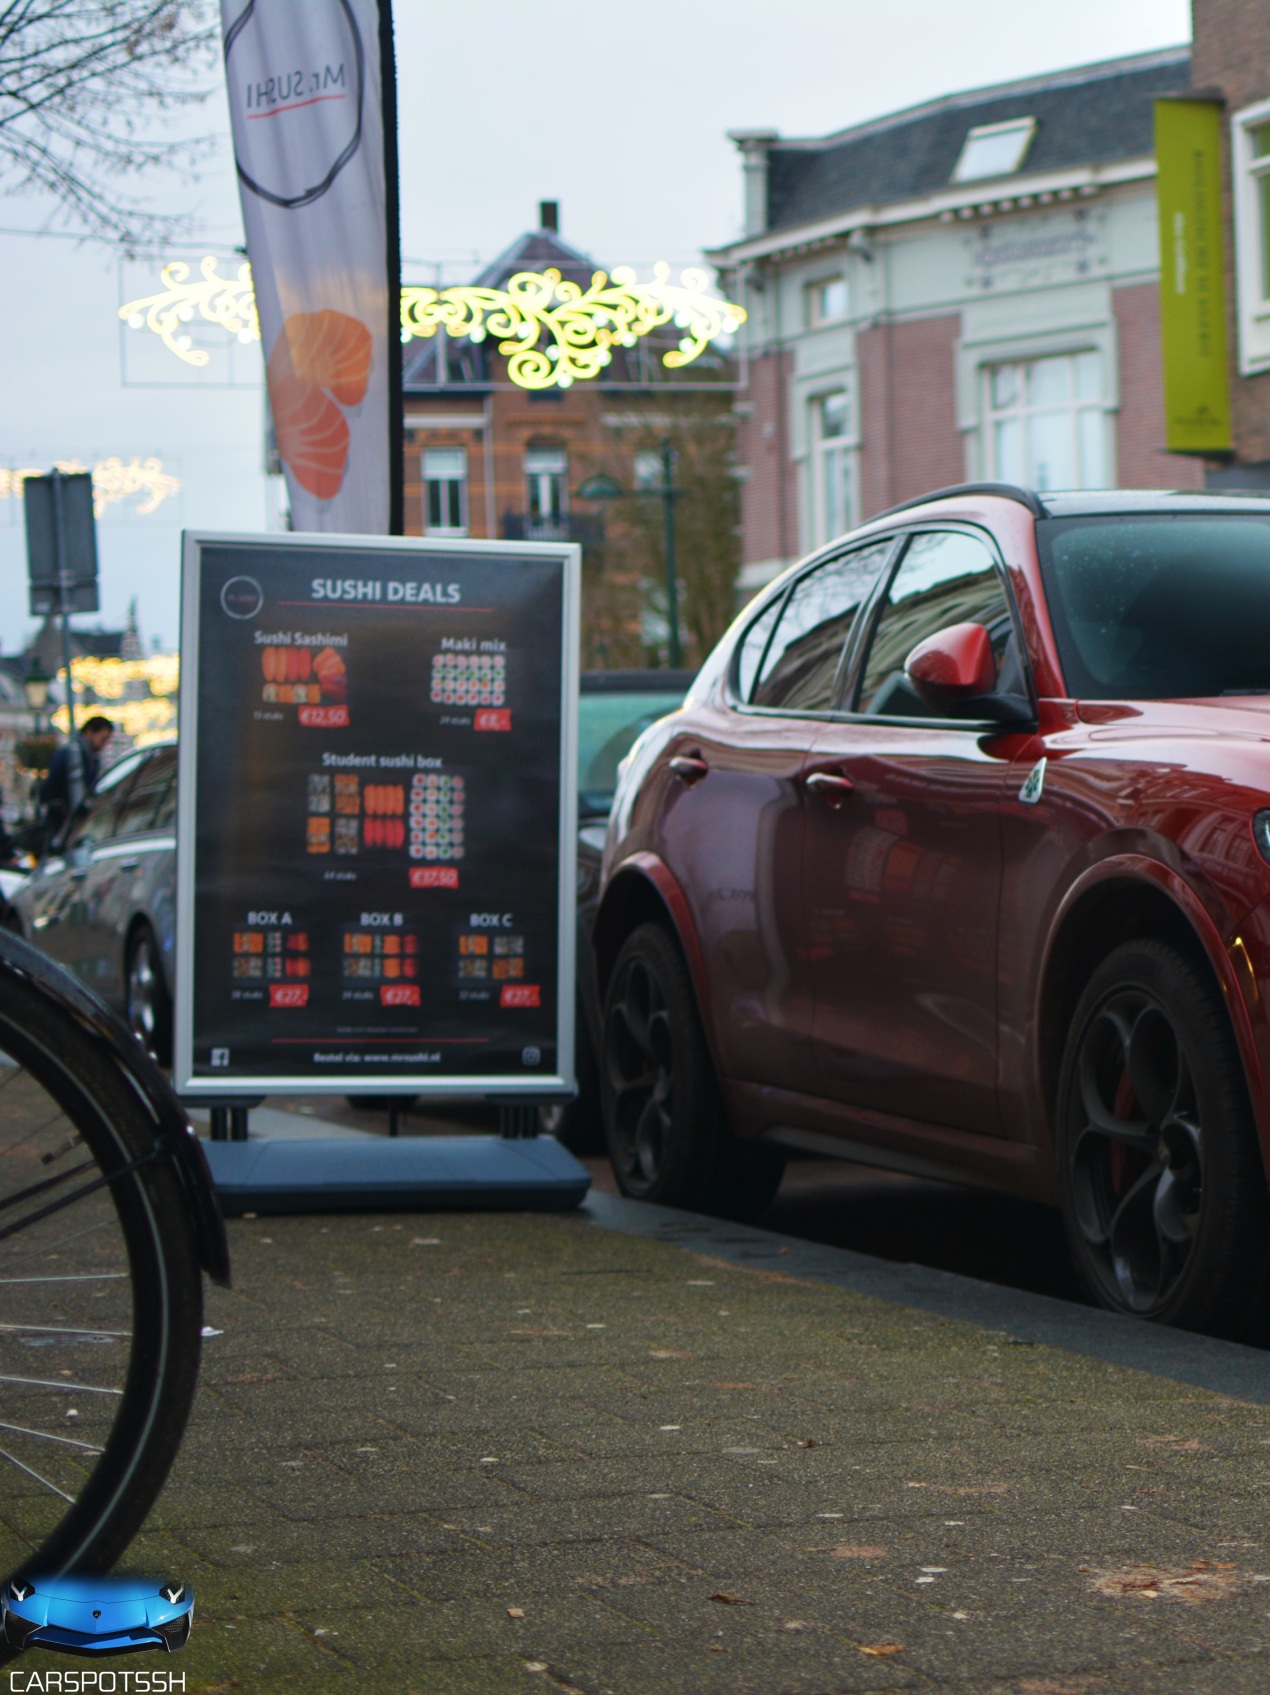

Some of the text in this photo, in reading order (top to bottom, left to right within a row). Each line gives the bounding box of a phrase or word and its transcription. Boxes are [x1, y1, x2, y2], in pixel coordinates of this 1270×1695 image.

[311, 578, 461, 603] SUSHI DEALS
[254, 630, 348, 647] Sushi Sashimi
[441, 637, 507, 652] Maki mix
[322, 752, 443, 768] Student sushi box
[247, 912, 292, 926] BOX A
[360, 912, 403, 926] BOX B
[470, 913, 513, 927] BOX C
[313, 1052, 343, 1063] Bestel
